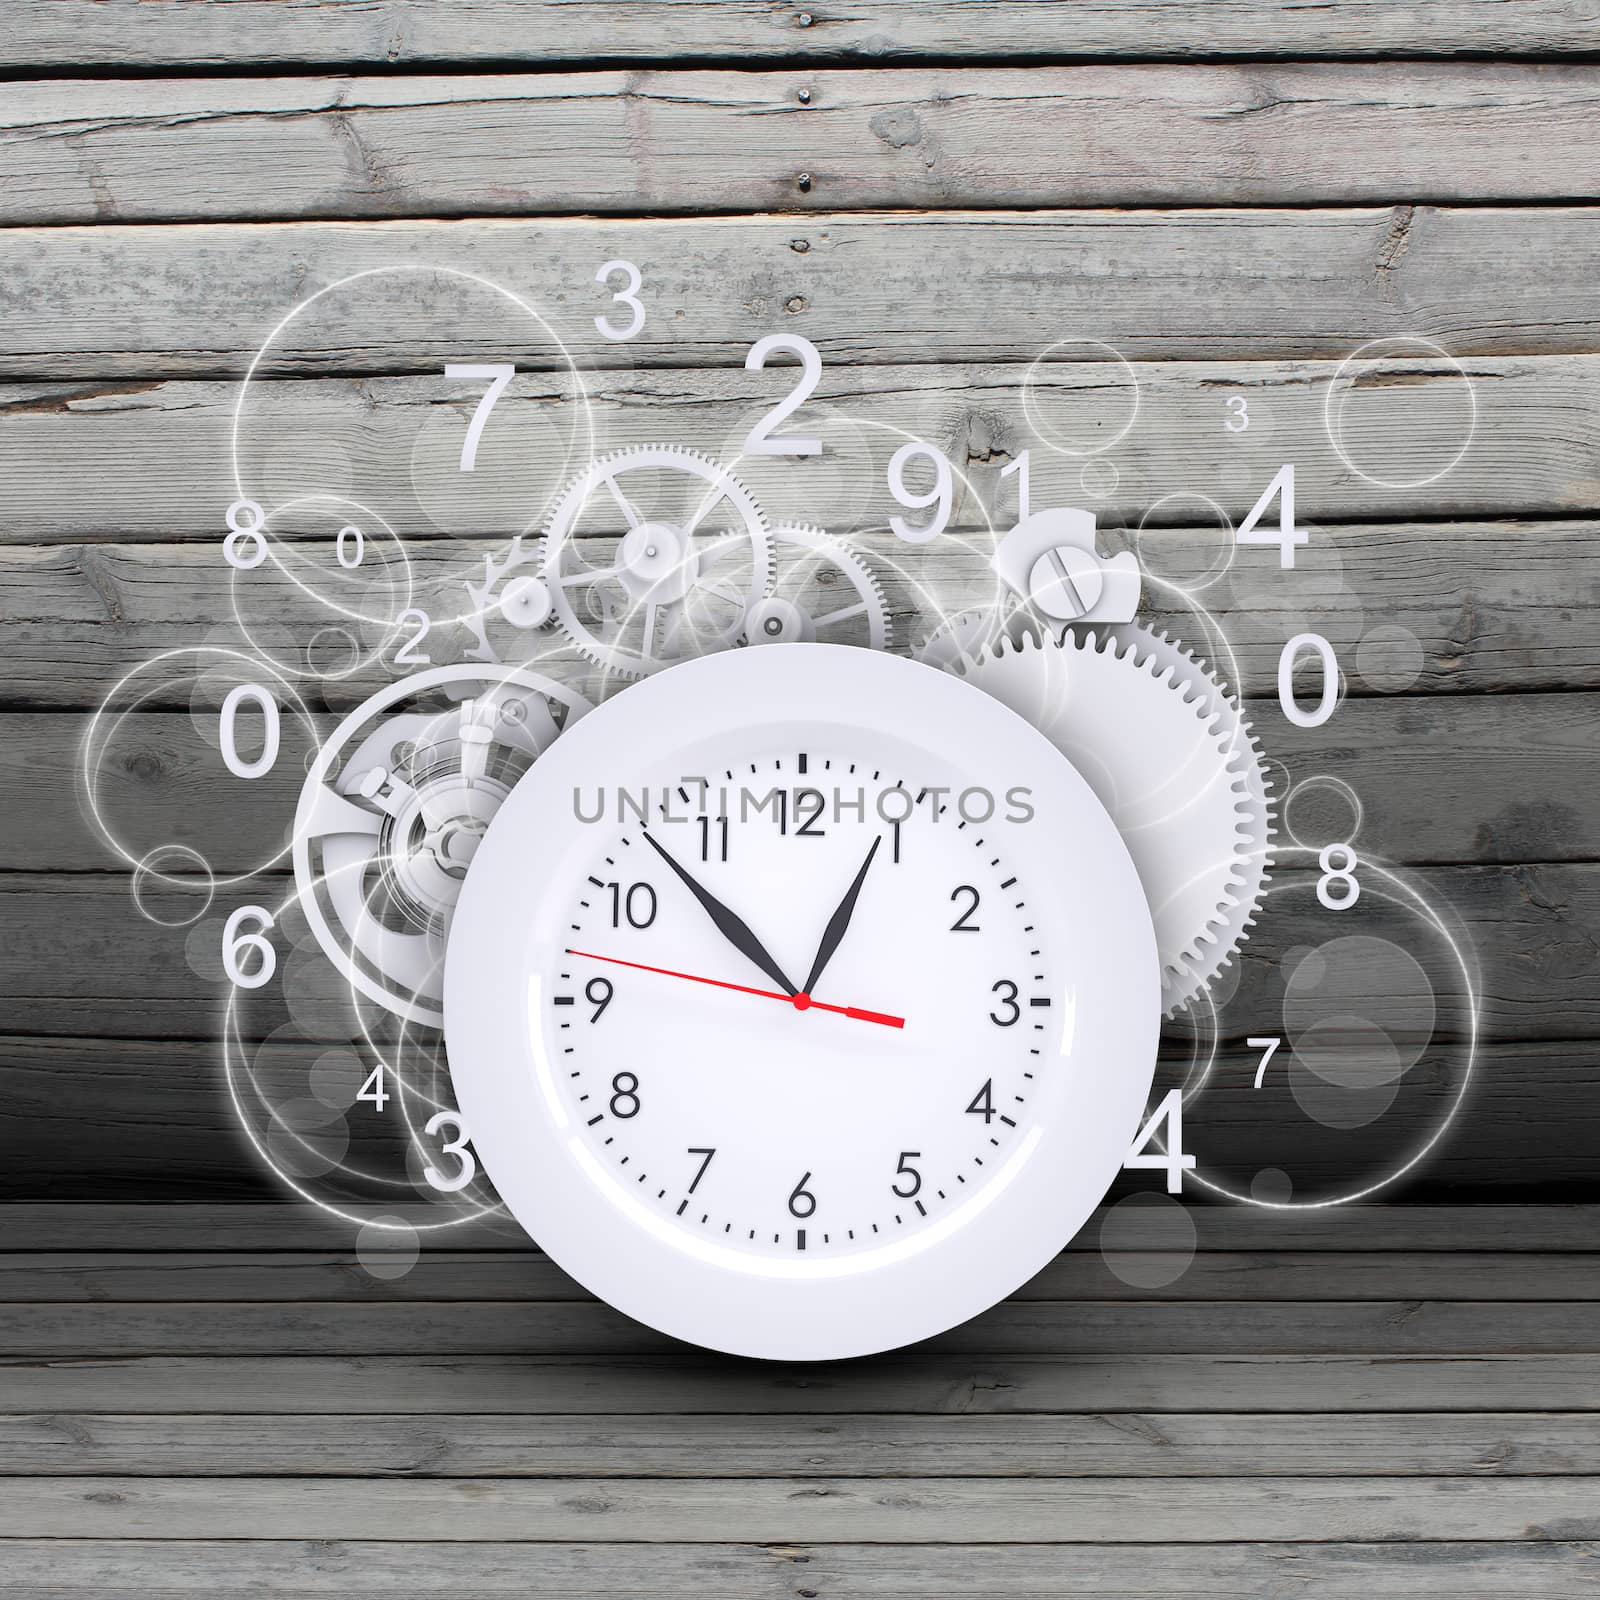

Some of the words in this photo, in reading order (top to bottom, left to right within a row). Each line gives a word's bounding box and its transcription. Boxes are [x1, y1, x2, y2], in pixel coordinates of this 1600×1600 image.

[593, 260, 646, 340] 3
[444, 364, 515, 472] 7
[743, 333, 823, 455] 2
[1225, 396, 1249, 432] 3
[887, 442, 952, 543] 9
[1000, 449, 1031, 518] 1
[223, 500, 268, 570] 8
[1236, 464, 1308, 568] 4
[336, 526, 364, 568] 0
[394, 608, 431, 664] 2
[1278, 633, 1339, 727] 0
[219, 684, 280, 779] 0
[776, 790, 825, 836] 12
[696, 816, 728, 862] 11
[887, 818, 900, 864] 1
[1316, 843, 1360, 910] 8
[607, 882, 657, 929] 10
[949, 885, 980, 932] 2
[222, 906, 276, 989] 6
[585, 977, 614, 1024] 9
[989, 980, 1020, 1027] 3
[1246, 1037, 1281, 1089] 7
[356, 1064, 390, 1113] 4
[609, 1071, 641, 1119] 8
[965, 1077, 997, 1124] 4
[423, 1111, 477, 1193] 3
[1123, 1089, 1197, 1194] 4
[687, 1147, 717, 1194] 7
[788, 1171, 817, 1219] 6
[891, 1151, 922, 1199] 5
